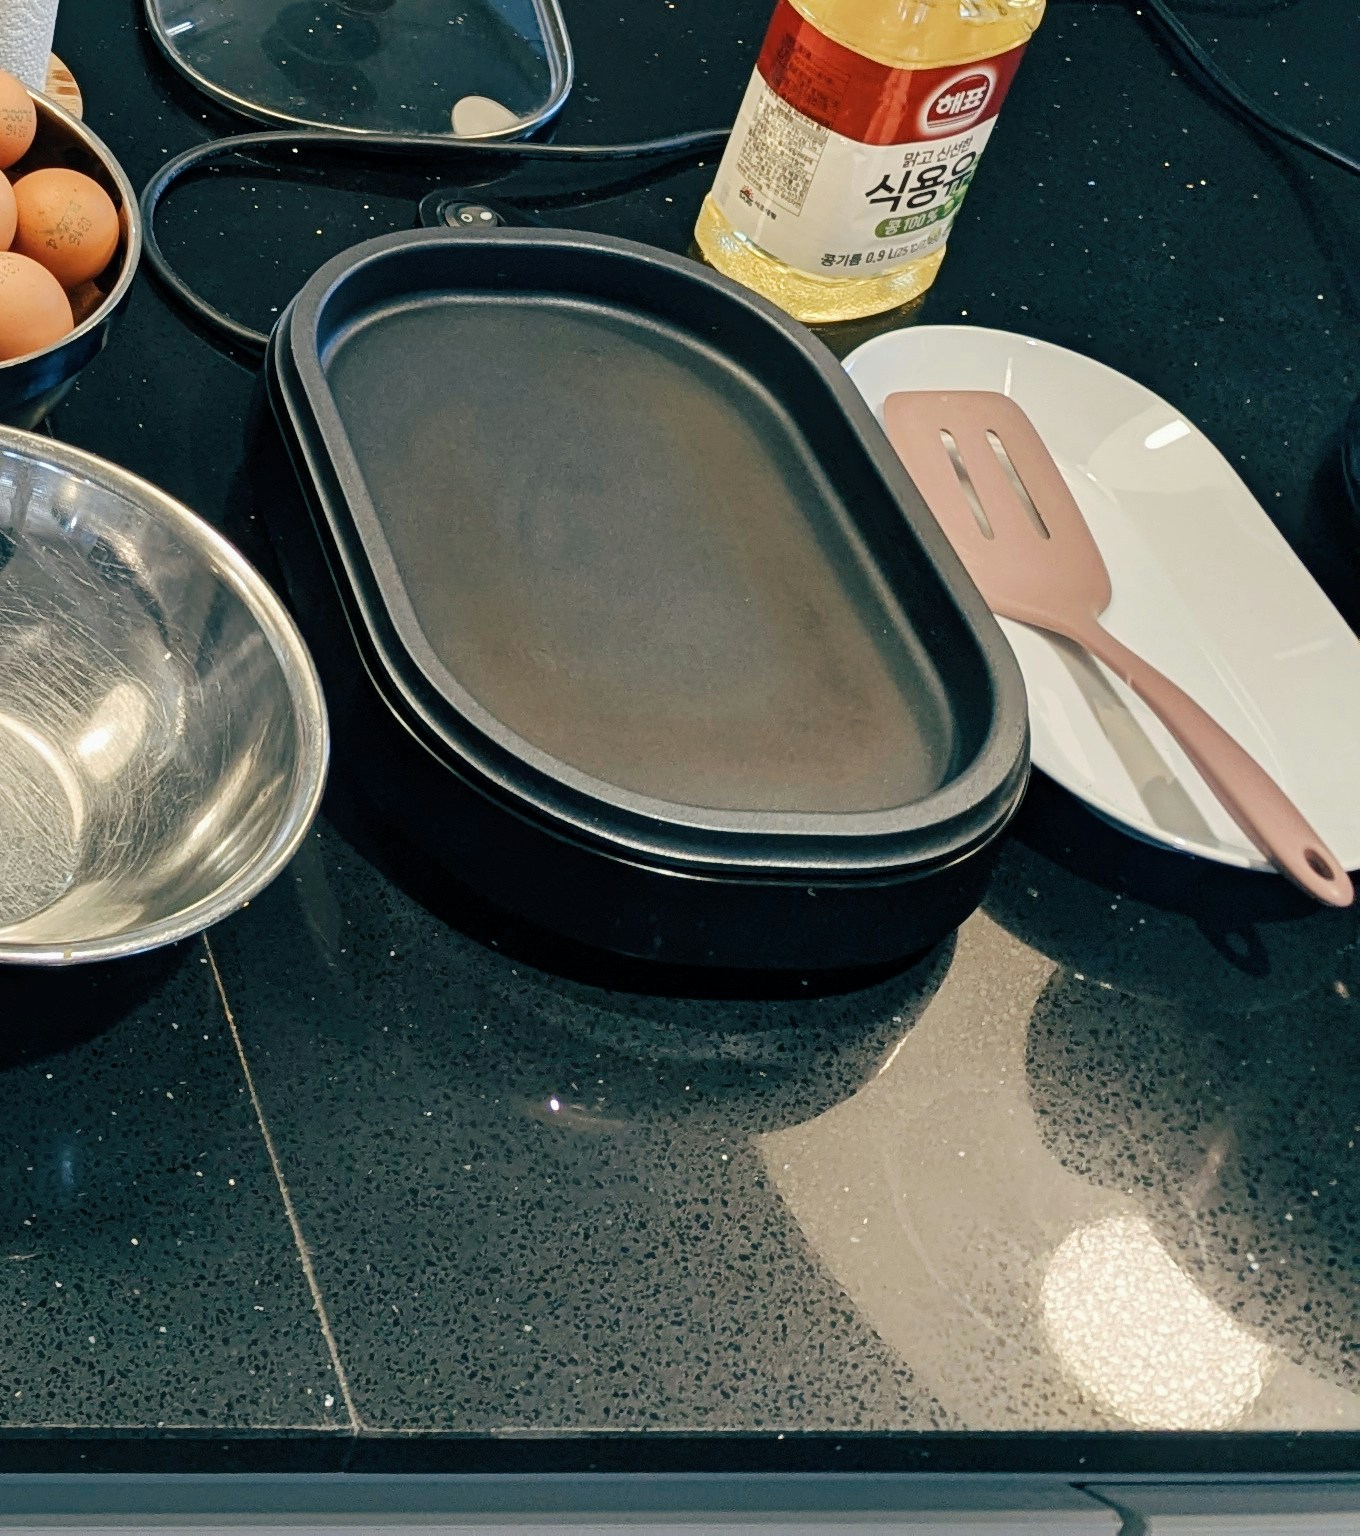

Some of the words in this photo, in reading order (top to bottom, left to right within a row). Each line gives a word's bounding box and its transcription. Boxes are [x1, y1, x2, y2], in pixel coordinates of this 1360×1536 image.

[936, 84, 985, 115] 해표
[902, 150, 935, 169] 맑고
[936, 136, 974, 162] 신선한
[865, 151, 977, 212] 식용유
[884, 219, 902, 236] 콩
[820, 252, 863, 267] 콩기름
[865, 250, 886, 264] 0.9
